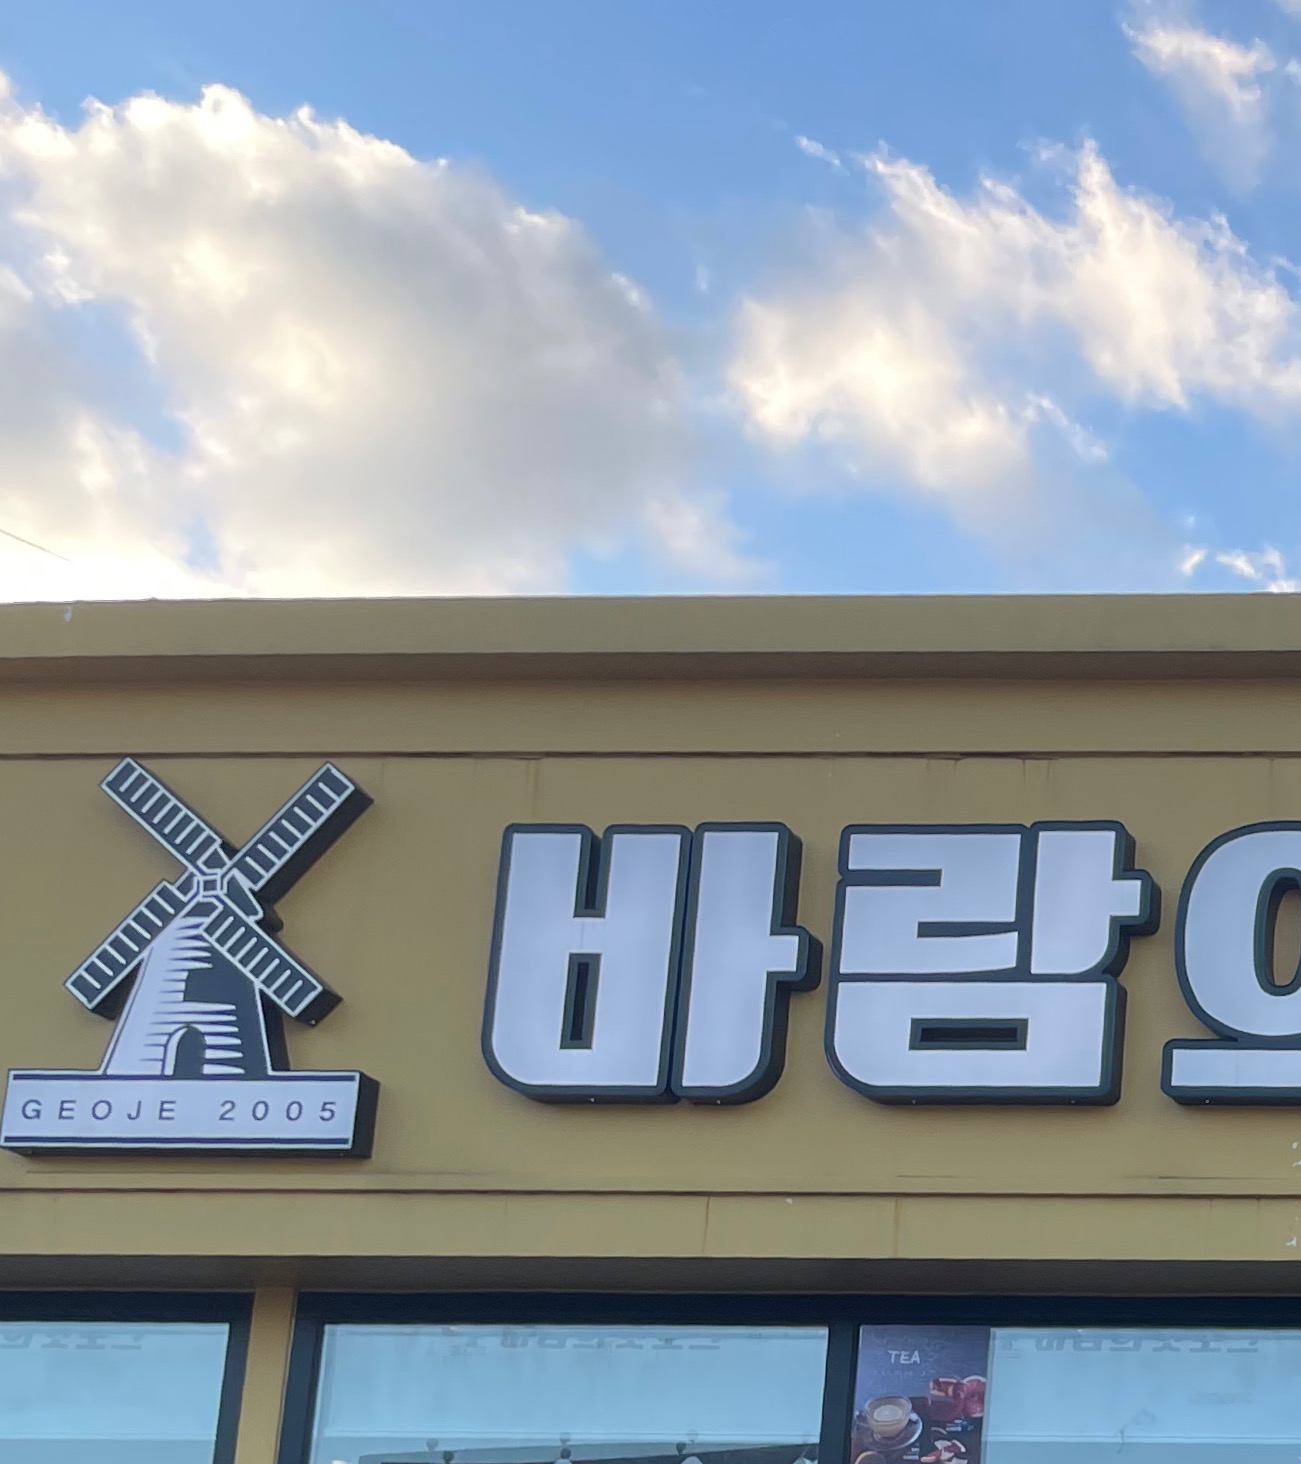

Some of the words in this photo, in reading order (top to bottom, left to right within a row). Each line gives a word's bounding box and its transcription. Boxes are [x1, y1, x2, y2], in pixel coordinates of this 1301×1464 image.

[21, 1099, 177, 1122] GEOJE
[218, 1099, 337, 1122] 2005
[888, 1350, 921, 1364] TEA
